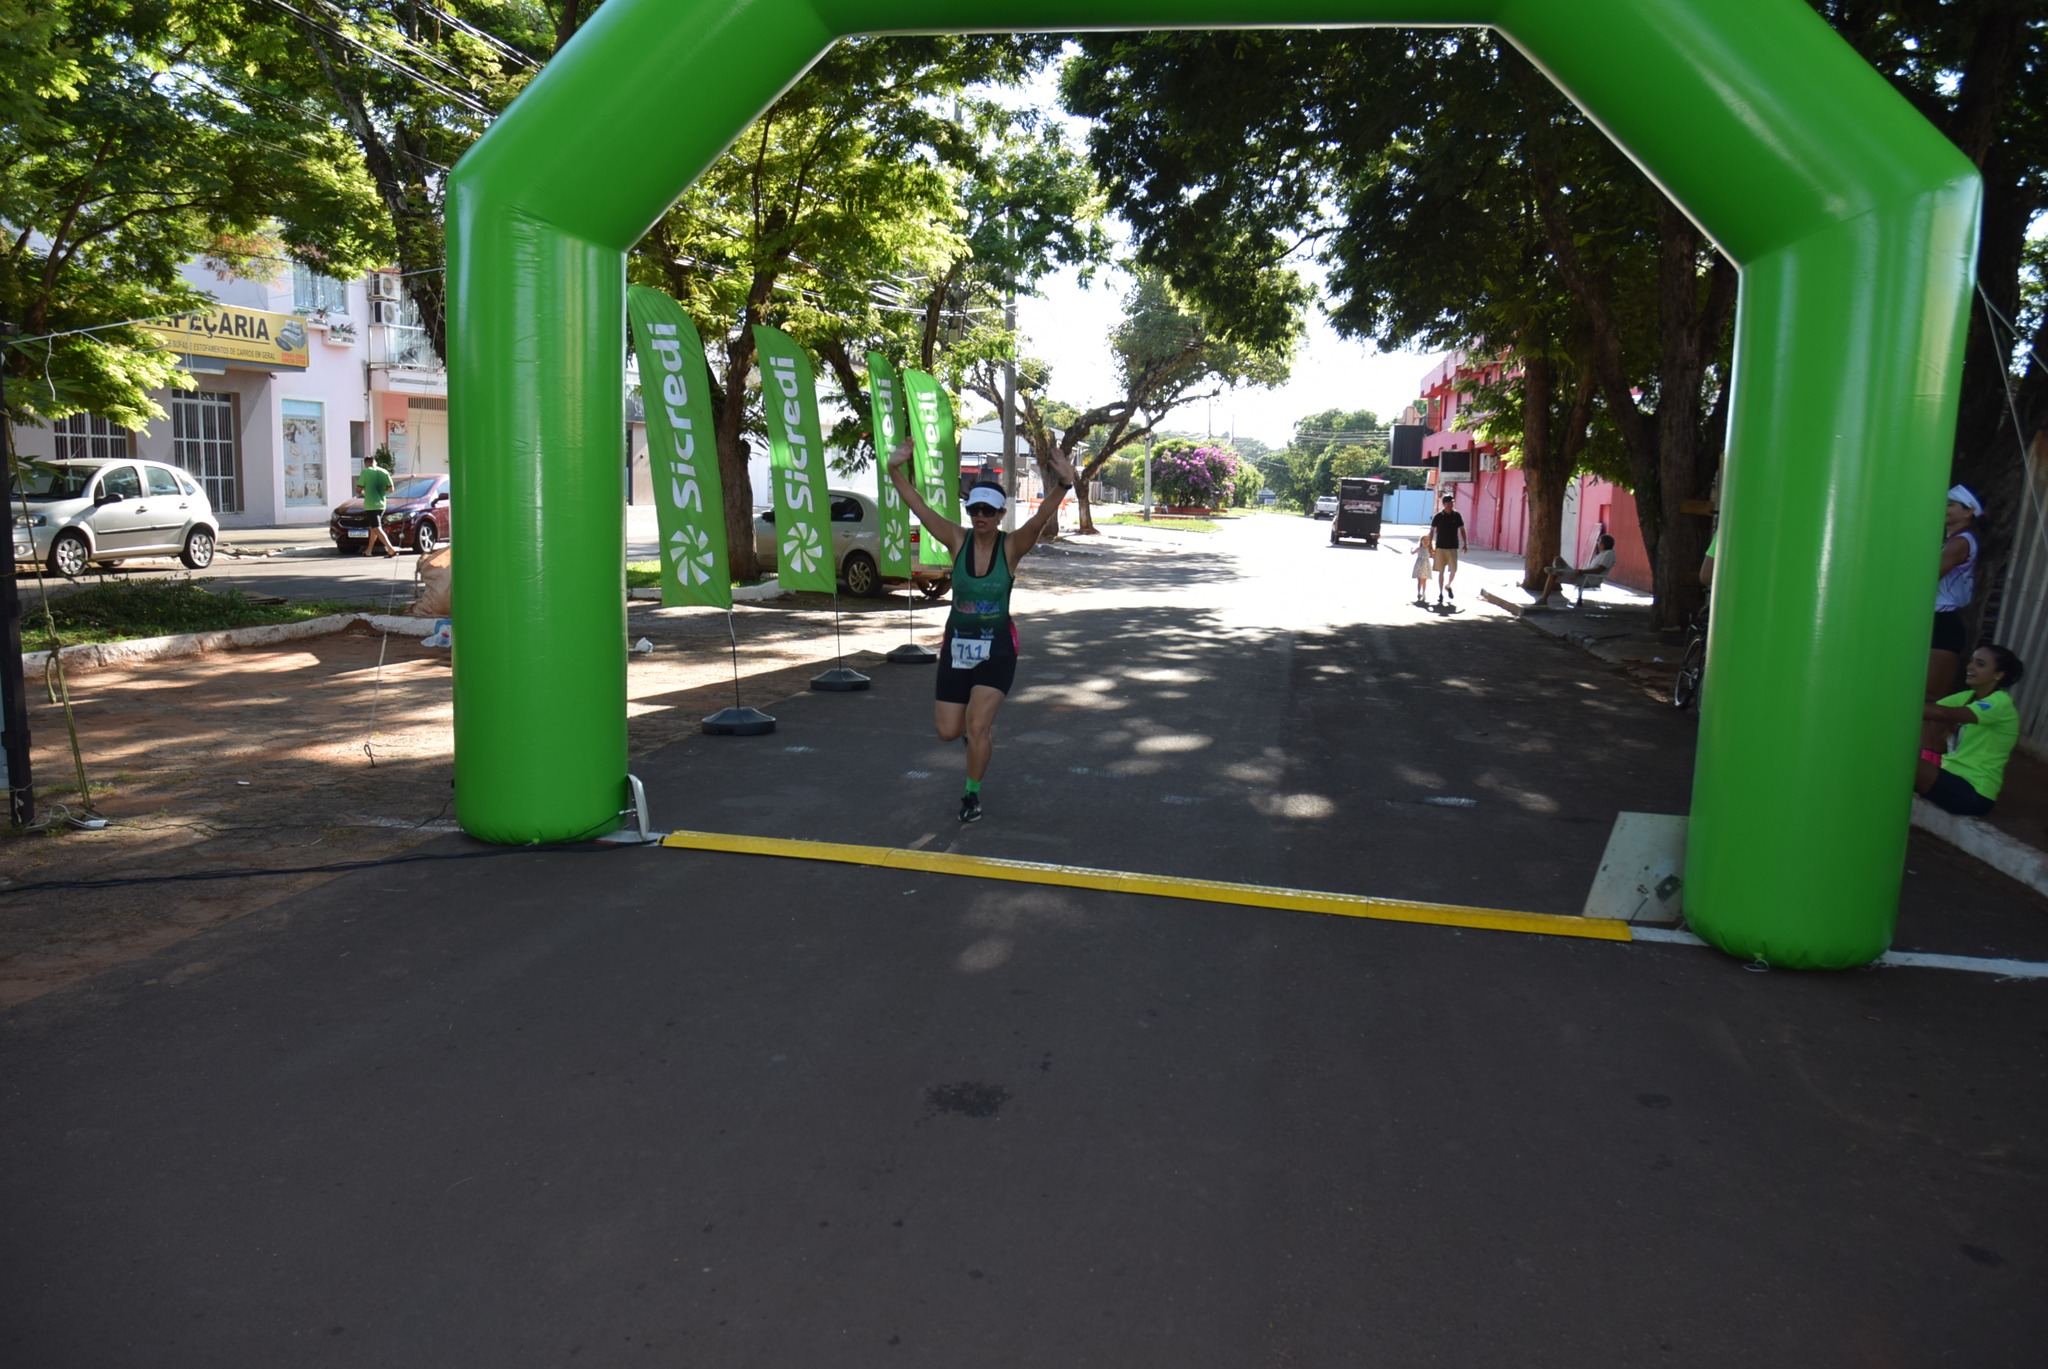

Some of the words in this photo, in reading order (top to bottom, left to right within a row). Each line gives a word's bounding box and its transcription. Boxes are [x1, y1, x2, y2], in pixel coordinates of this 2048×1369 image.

[146, 311, 270, 341] PEÇARIA
[193, 343, 229, 354] ESTOFAMENTOS
[230, 347, 236, 355] DE
[236, 348, 254, 357] CARROS
[255, 350, 261, 358] EM
[262, 351, 276, 360] GERAL
[646, 323, 702, 512] Sicredi
[769, 356, 813, 513] Sicredi
[877, 378, 900, 511] Siredi
[917, 391, 946, 508] Sicredi
[957, 643, 984, 660] 711
